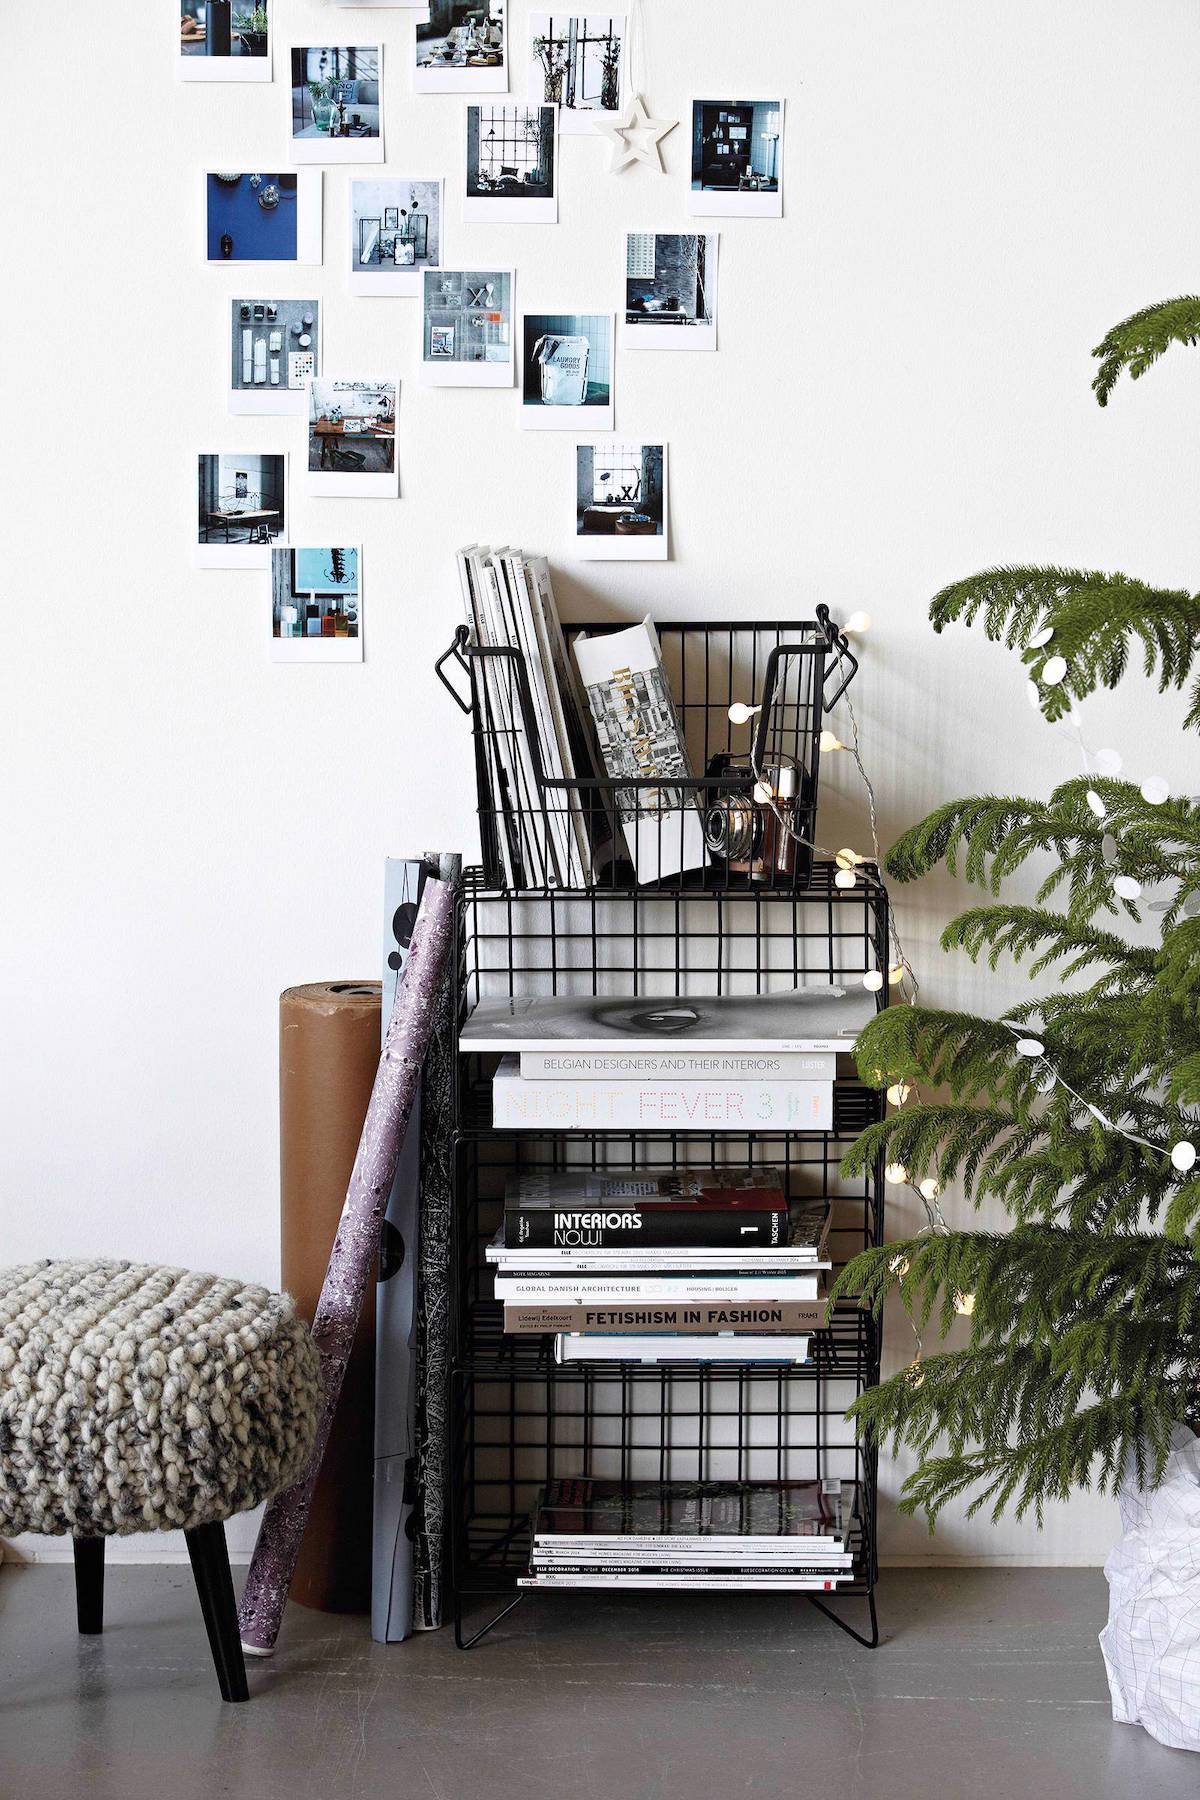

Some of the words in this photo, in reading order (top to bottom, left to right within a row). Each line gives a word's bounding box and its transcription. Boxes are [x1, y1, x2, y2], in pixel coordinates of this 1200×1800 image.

[543, 1058, 591, 1070] BELGIAN
[594, 1059, 658, 1070] DESIGNERS
[660, 1060, 686, 1070] AND
[688, 1060, 720, 1070] THEIR
[722, 1060, 780, 1070] INTERIORS
[506, 1090, 624, 1119] NIGHT
[640, 1092, 744, 1119] FEVER
[757, 1092, 773, 1120] 3
[554, 1212, 642, 1230] INTERIORS
[771, 1212, 779, 1244] TASCHEN
[554, 1230, 602, 1246] NOW!
[740, 1226, 759, 1234] 1
[586, 1312, 677, 1325] FETISHISM
[684, 1310, 700, 1324] IN
[708, 1310, 782, 1323] FASHION
